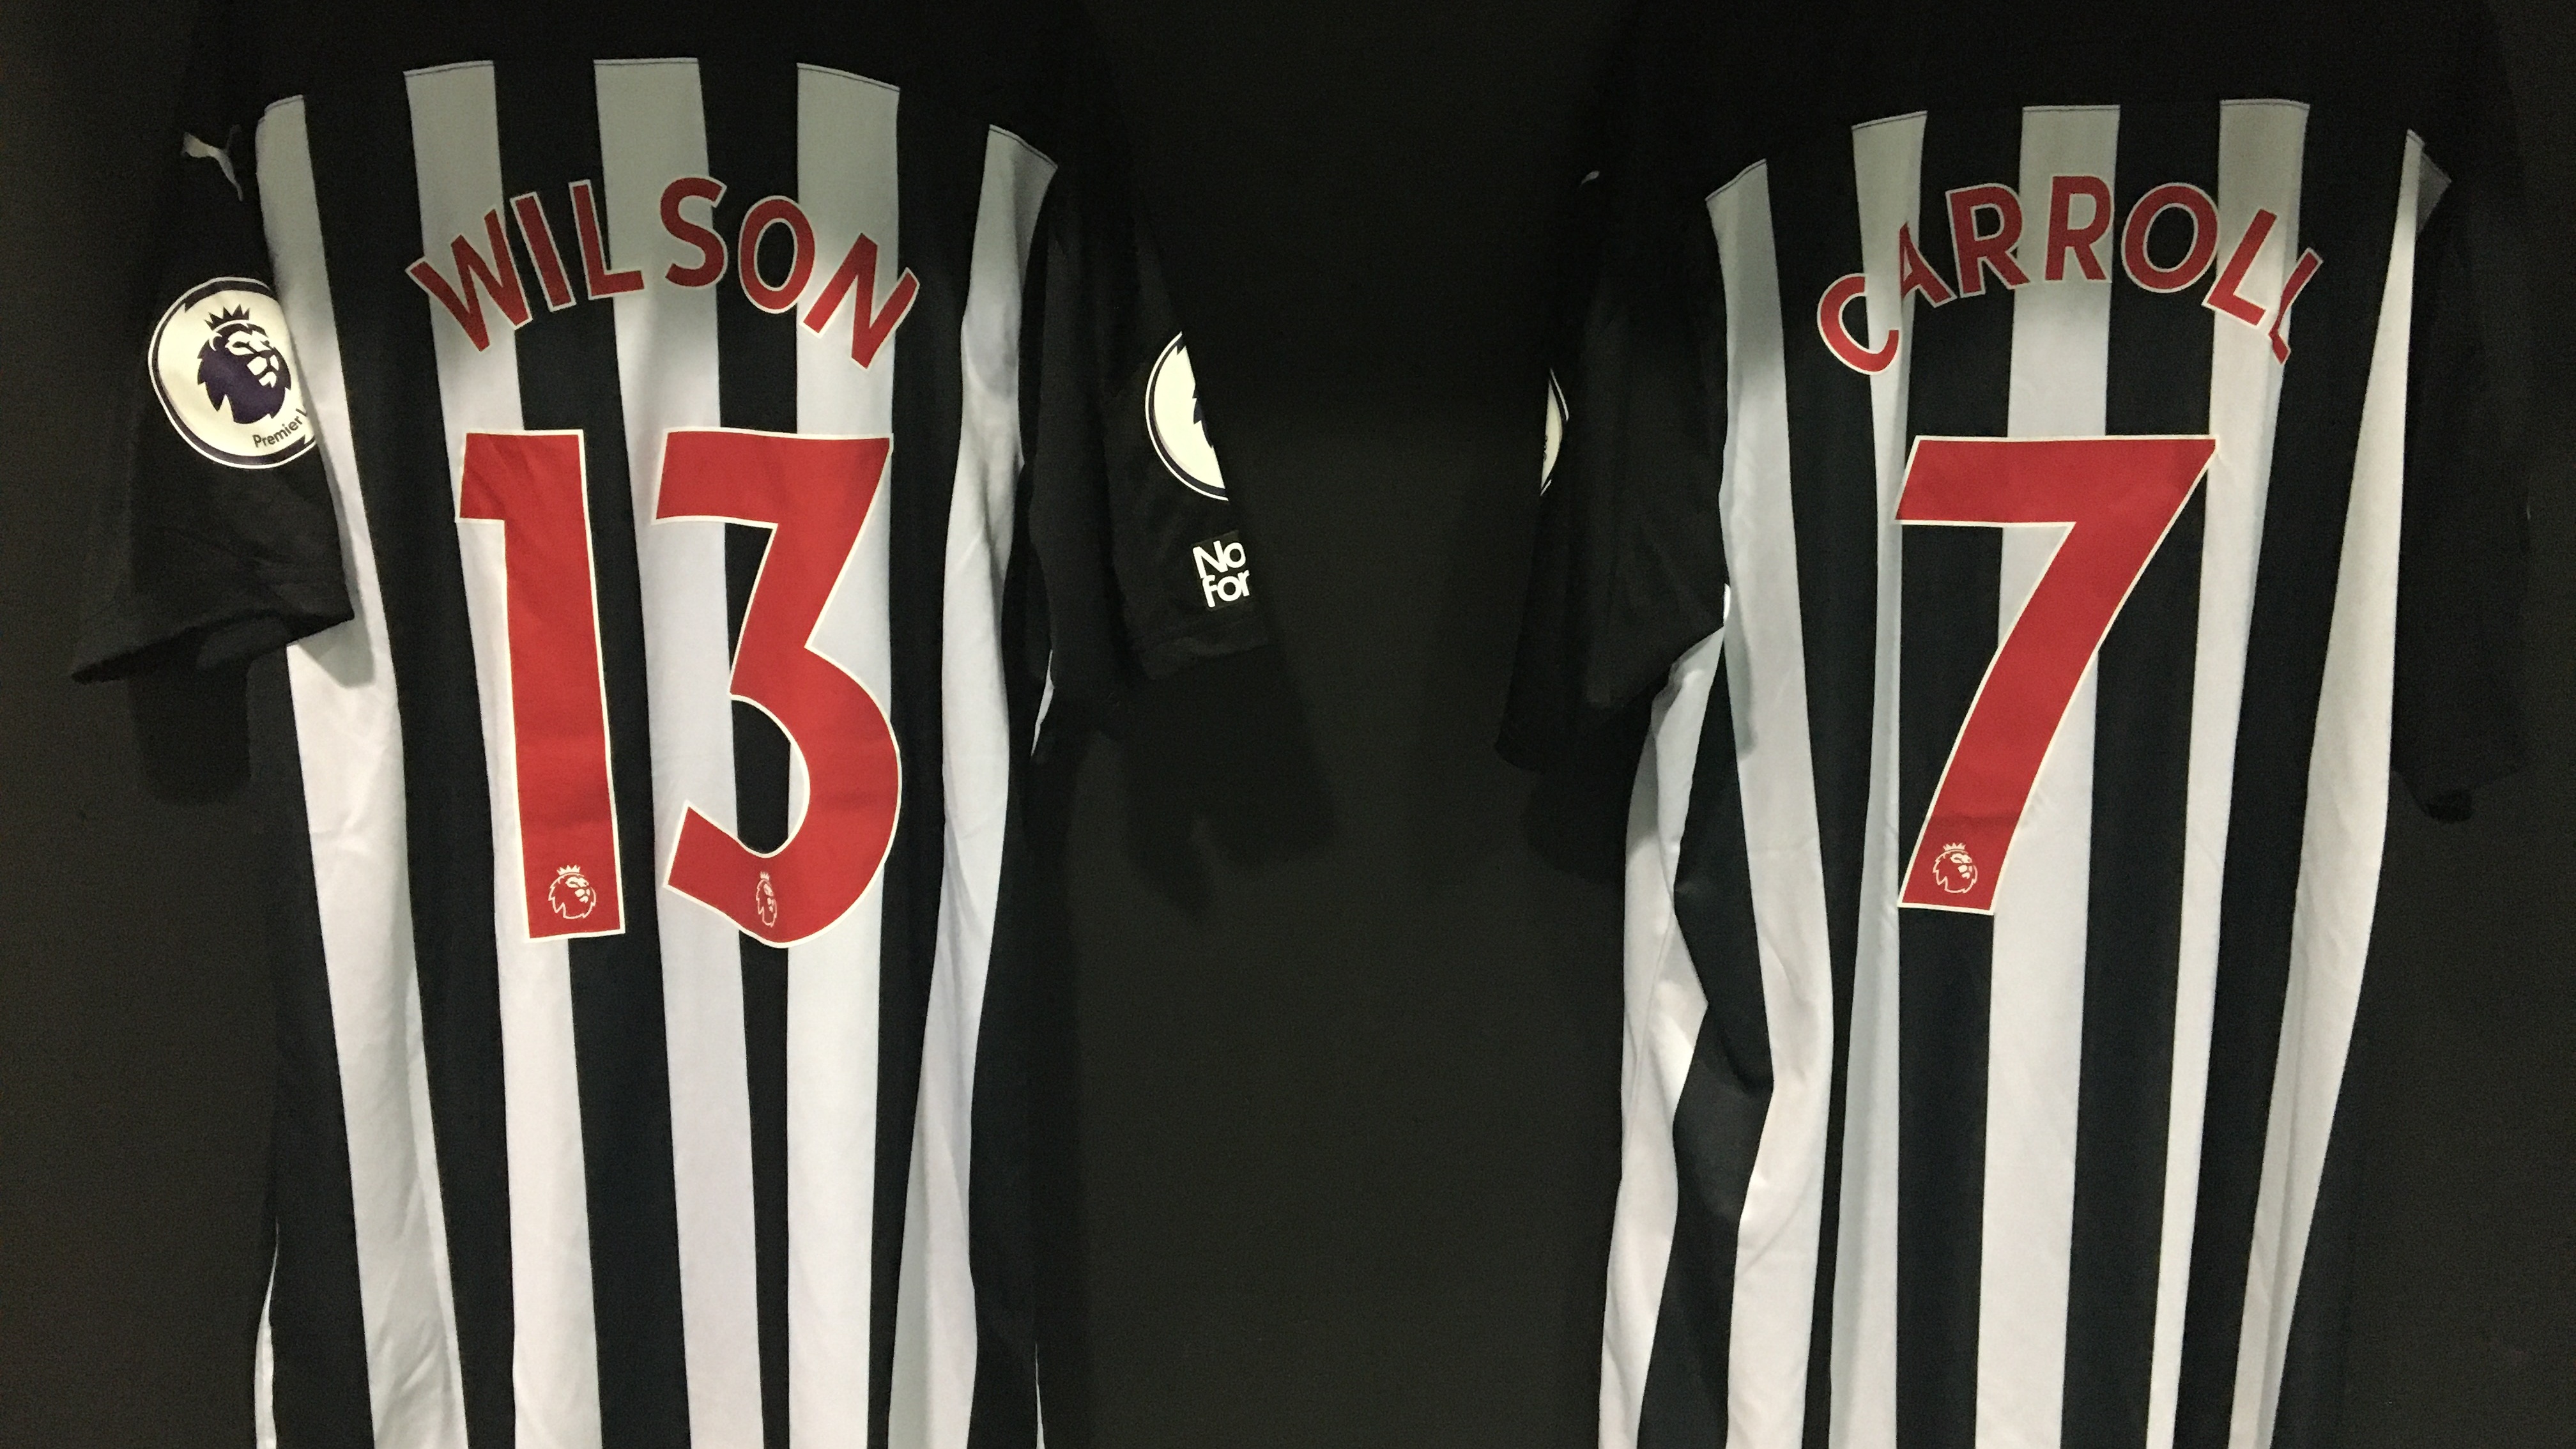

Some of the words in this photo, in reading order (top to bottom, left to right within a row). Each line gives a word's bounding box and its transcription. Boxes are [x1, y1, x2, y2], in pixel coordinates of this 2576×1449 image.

[405, 176, 919, 371] WILSON
[252, 416, 303, 448] Premier
[1192, 540, 1246, 579] No
[1202, 569, 1250, 608] for
[455, 426, 902, 948] 13
[1895, 434, 2219, 916] 7
